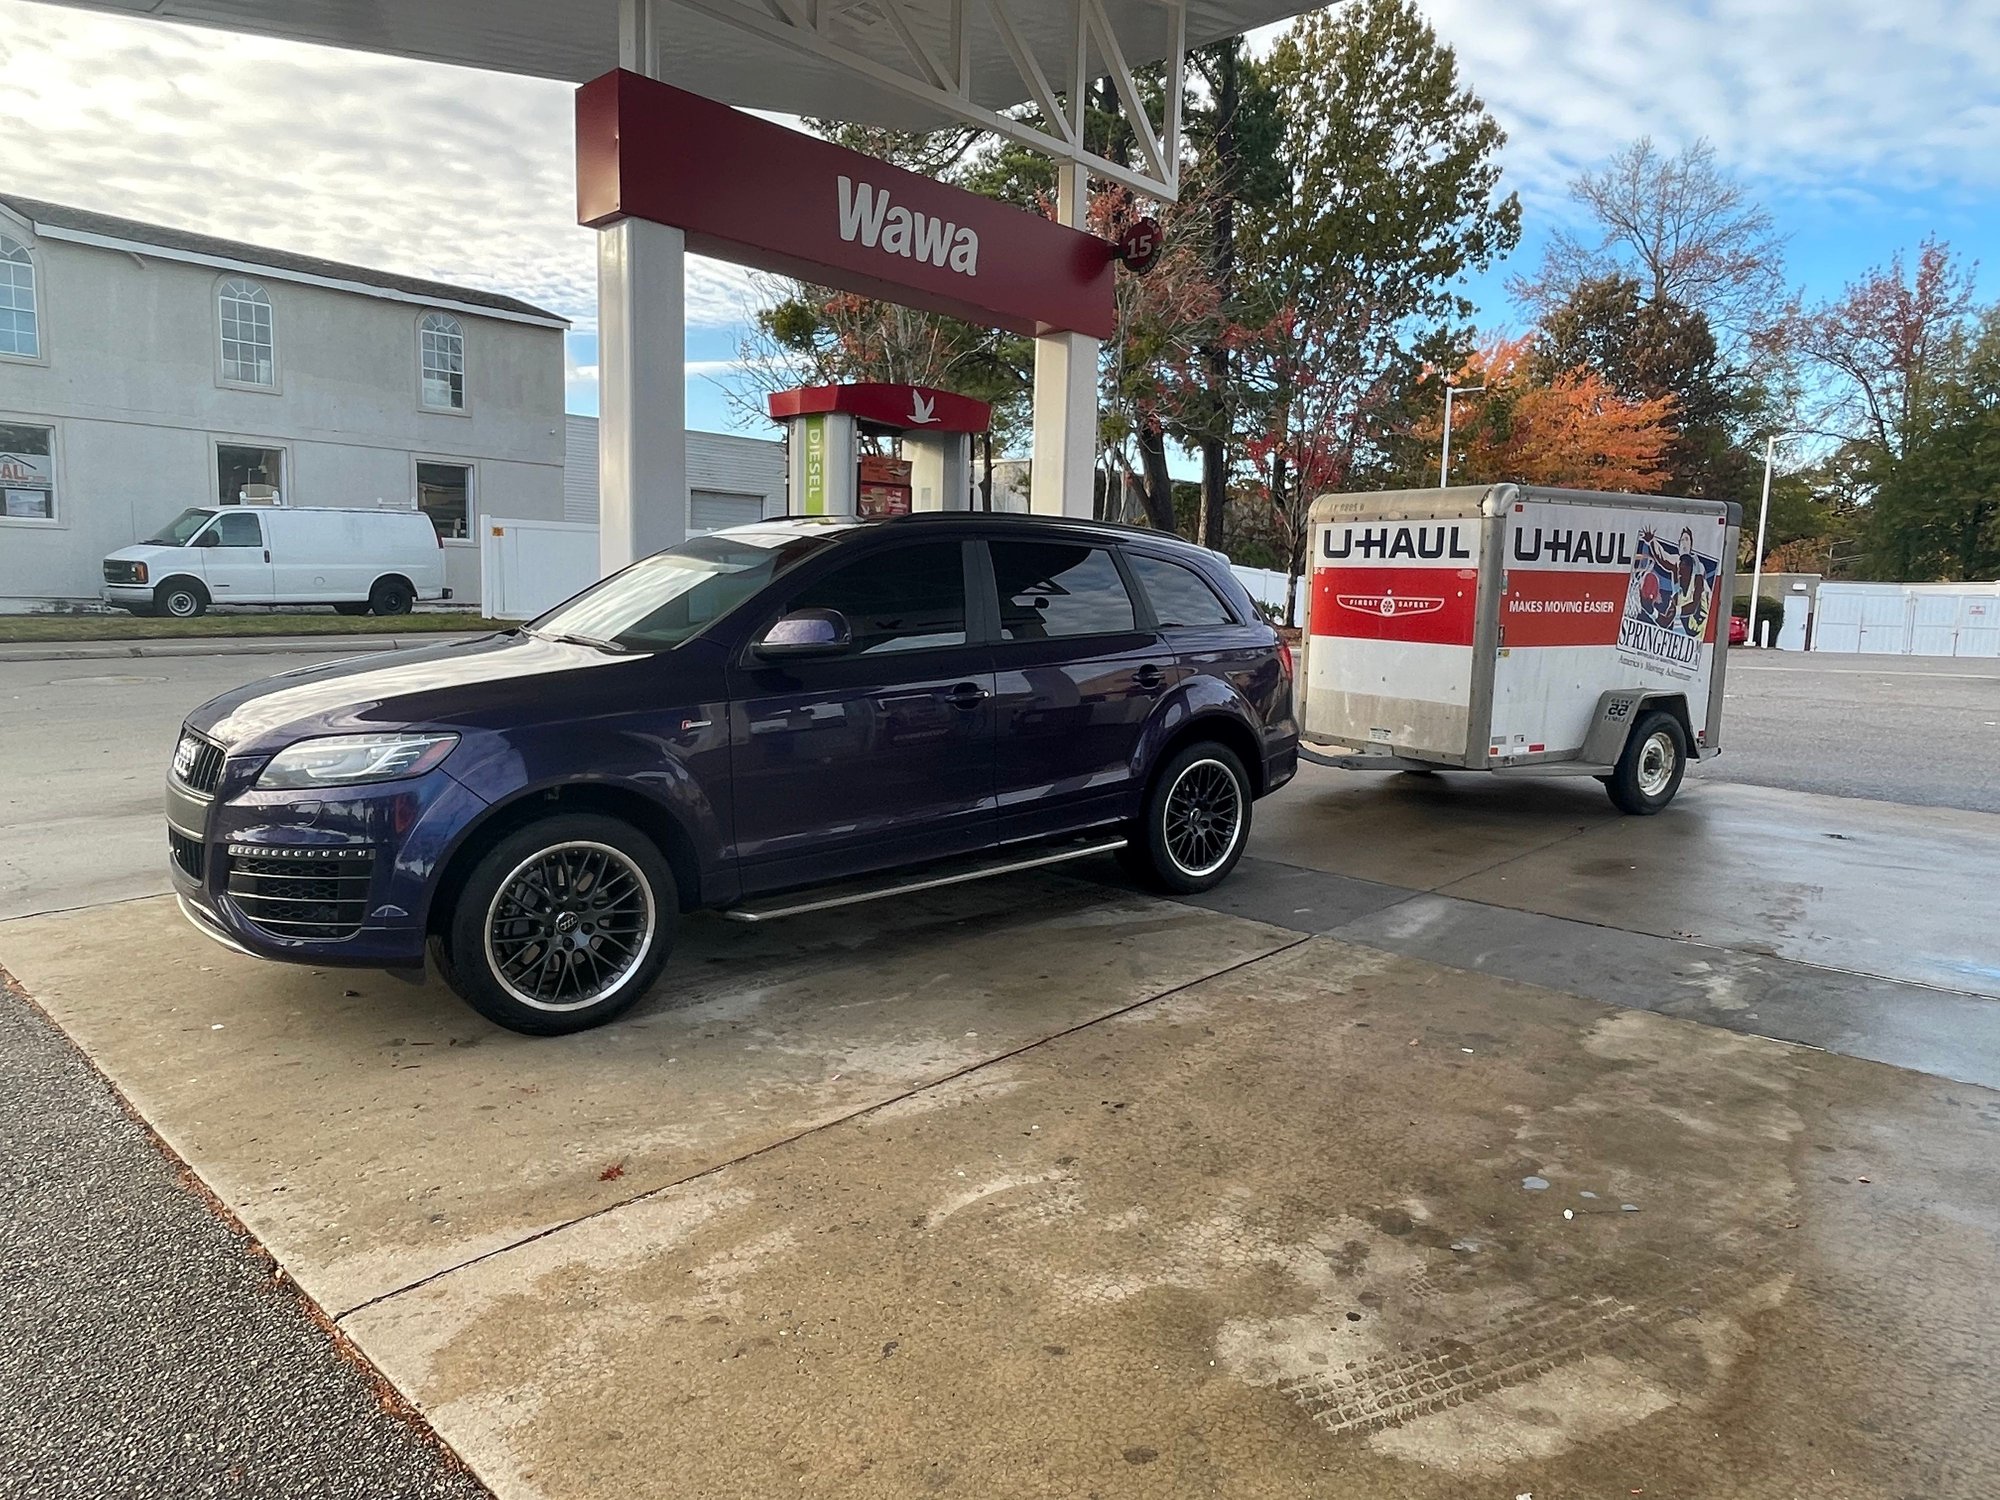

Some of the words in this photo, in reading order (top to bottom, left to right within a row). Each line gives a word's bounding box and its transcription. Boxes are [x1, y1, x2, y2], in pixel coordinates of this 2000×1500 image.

[837, 175, 979, 276] Wawa
[1127, 234, 1152, 259] 15
[808, 428, 821, 498] DIESEL
[1323, 526, 1470, 559] U-HAUL
[1514, 527, 1632, 565] U-HAUL
[1398, 600, 1430, 608] SAFEST
[1509, 600, 1543, 613] MAKES
[1544, 601, 1582, 613] MOVING
[1583, 601, 1614, 613] EASIER
[1618, 619, 1695, 663] SPRINGFIELD
